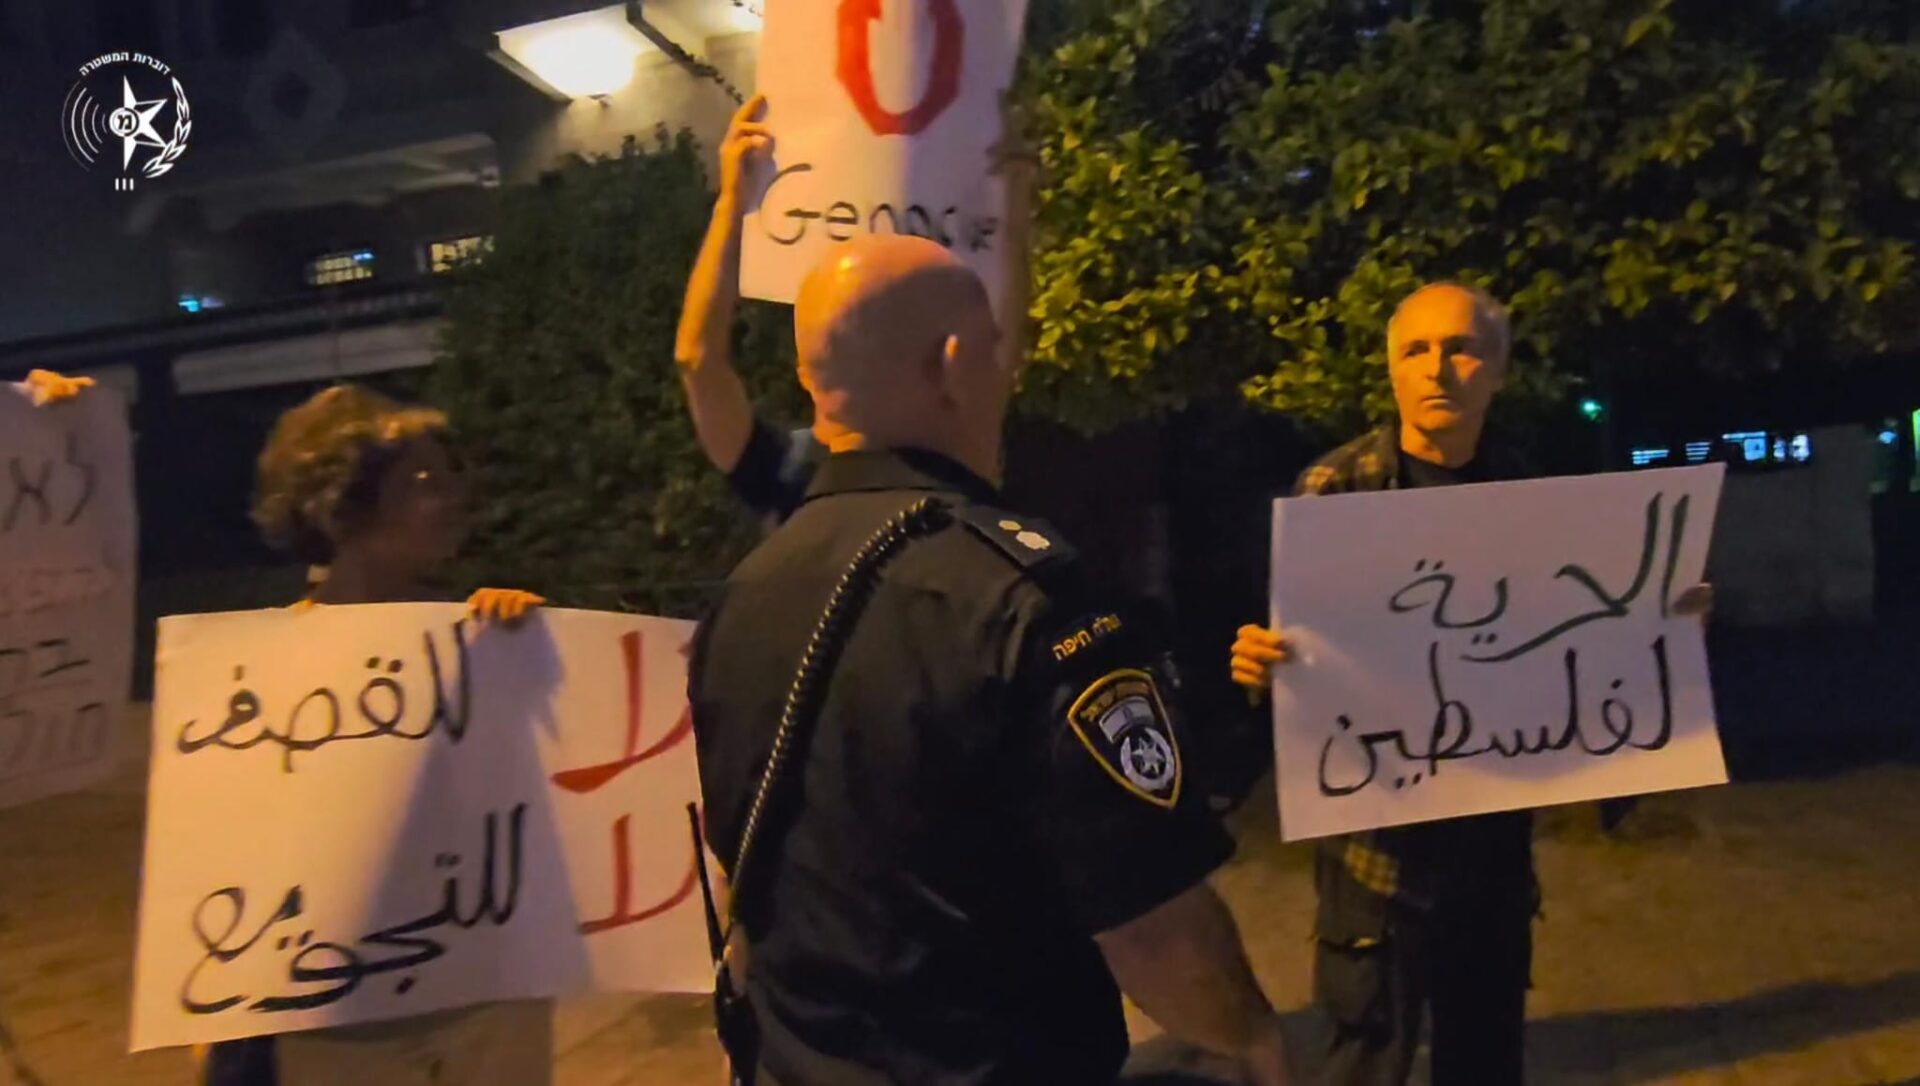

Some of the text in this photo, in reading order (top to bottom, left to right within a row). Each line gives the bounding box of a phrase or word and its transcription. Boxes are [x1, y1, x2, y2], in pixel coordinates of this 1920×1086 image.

[1051, 629, 1092, 662] חיפה
[1389, 490, 1690, 663] الحرية
[176, 618, 472, 774] للقصف
[1318, 634, 1674, 797] لفلسطين
[180, 802, 702, 1014] لا للتجويع
